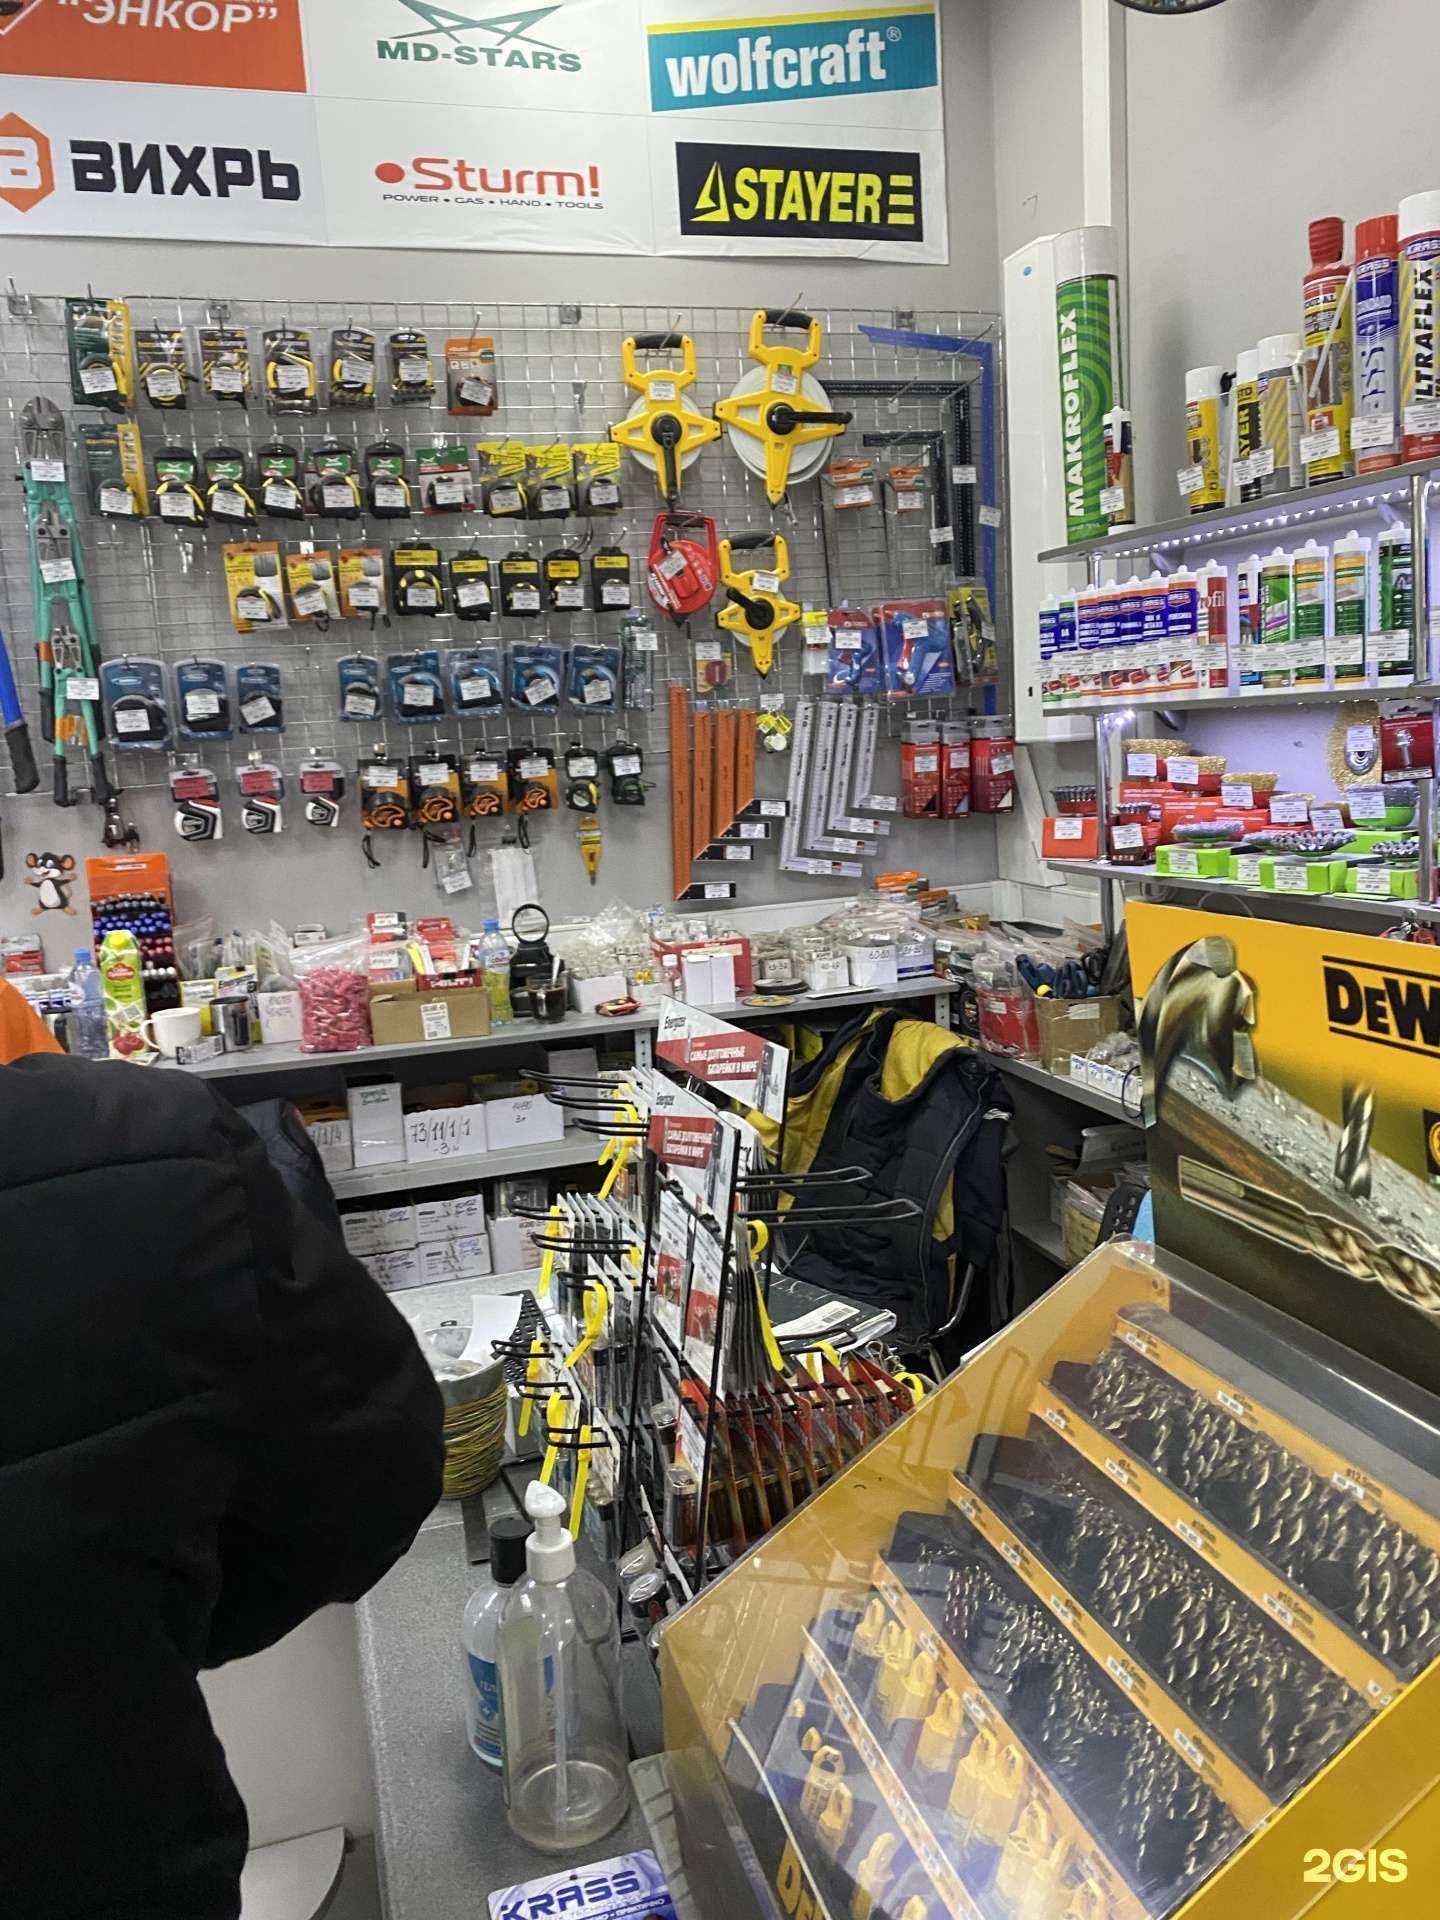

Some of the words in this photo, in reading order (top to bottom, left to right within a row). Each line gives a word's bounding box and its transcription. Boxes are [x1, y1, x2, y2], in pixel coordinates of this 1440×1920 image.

[376, 39, 582, 72] MD-STARS
[69, 139, 301, 201] ВИХРЬ
[412, 157, 601, 198] Sturm!
[382, 194, 440, 205] POWER
[455, 196, 486, 206] GAS
[500, 198, 541, 208] HAND
[556, 201, 604, 210] TOOLS
[733, 166, 882, 225] STAYER
[1059, 308, 1085, 517] MAKROFLEX
[501, 1870, 641, 1920] KRASS
